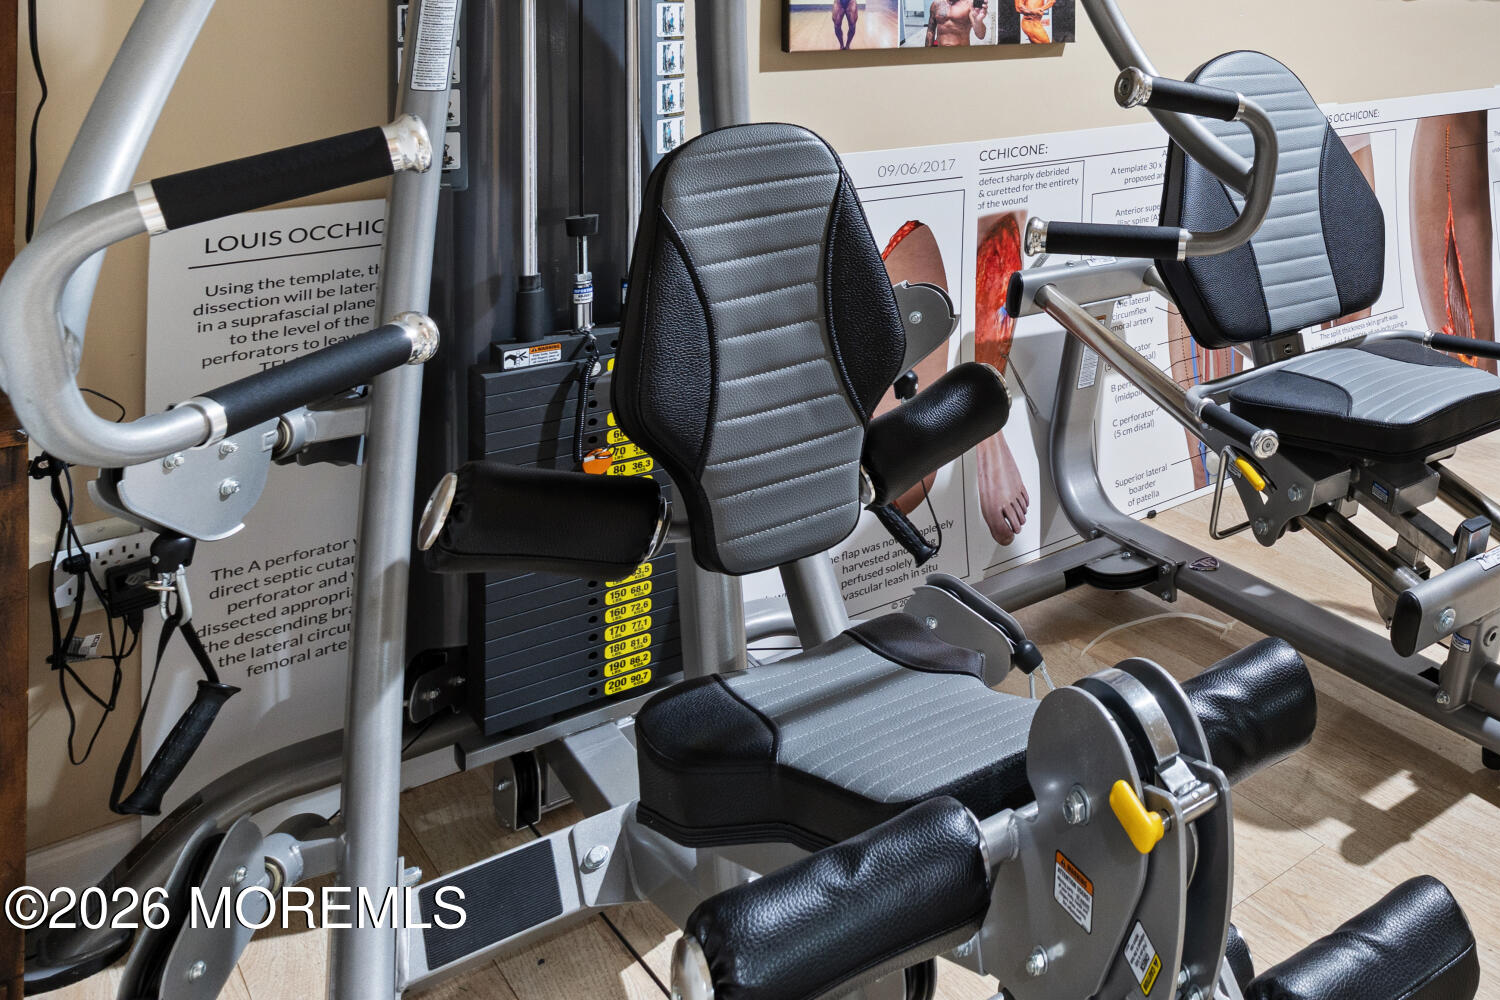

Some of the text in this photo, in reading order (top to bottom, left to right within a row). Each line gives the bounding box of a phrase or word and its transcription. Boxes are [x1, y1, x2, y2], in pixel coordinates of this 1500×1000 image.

[1333, 108, 1380, 123] OCCHICONE:
[978, 143, 1049, 162] CCHICONE:
[877, 158, 957, 179] 09/06/2017
[978, 165, 1070, 187] defect sharply debrided
[1111, 167, 1117, 175] A
[1118, 163, 1148, 174] template
[978, 176, 1080, 199] & curetted for the entirety
[1124, 173, 1156, 185] proposed
[977, 194, 1029, 210] of the wound
[1115, 205, 1143, 217] Anterior
[205, 230, 282, 254] LOUIS
[205, 267, 365, 297] Using the template,
[193, 281, 378, 316] dissection will be later
[1129, 294, 1152, 308] lateral
[197, 299, 376, 333] in a suprafascial plane
[1112, 307, 1148, 321] circumflex
[1133, 317, 1154, 328] artery
[230, 315, 370, 345] to the level of the
[202, 339, 319, 370] perforators to
[1111, 384, 1116, 393] B
[1112, 408, 1155, 428] C perforator
[1113, 419, 1155, 440] (5 cm distal)
[614, 447, 626, 457] 70
[613, 459, 650, 474] 80 36.3
[1115, 463, 1168, 488] Superior lateral
[1128, 480, 1157, 496] boarder
[1127, 490, 1160, 507] of patella
[210, 539, 350, 582] The A perforator
[841, 542, 881, 562] flap was
[841, 559, 913, 589] perfused solely
[842, 556, 890, 575] harvested
[209, 565, 313, 600] direct septic
[610, 583, 649, 600] 150 68.0
[842, 562, 938, 601] vascular leash in situ
[227, 571, 348, 615] perforator and
[610, 601, 649, 618] 160 72.6
[196, 607, 277, 638] dissected
[609, 618, 648, 636] 170 77.1
[202, 613, 329, 653] the descending
[218, 634, 303, 668] the lateral
[609, 636, 648, 654] 180 81.6
[246, 649, 311, 678] femoral
[609, 653, 648, 672] 190 86.2
[608, 672, 649, 690] 200 90.7
